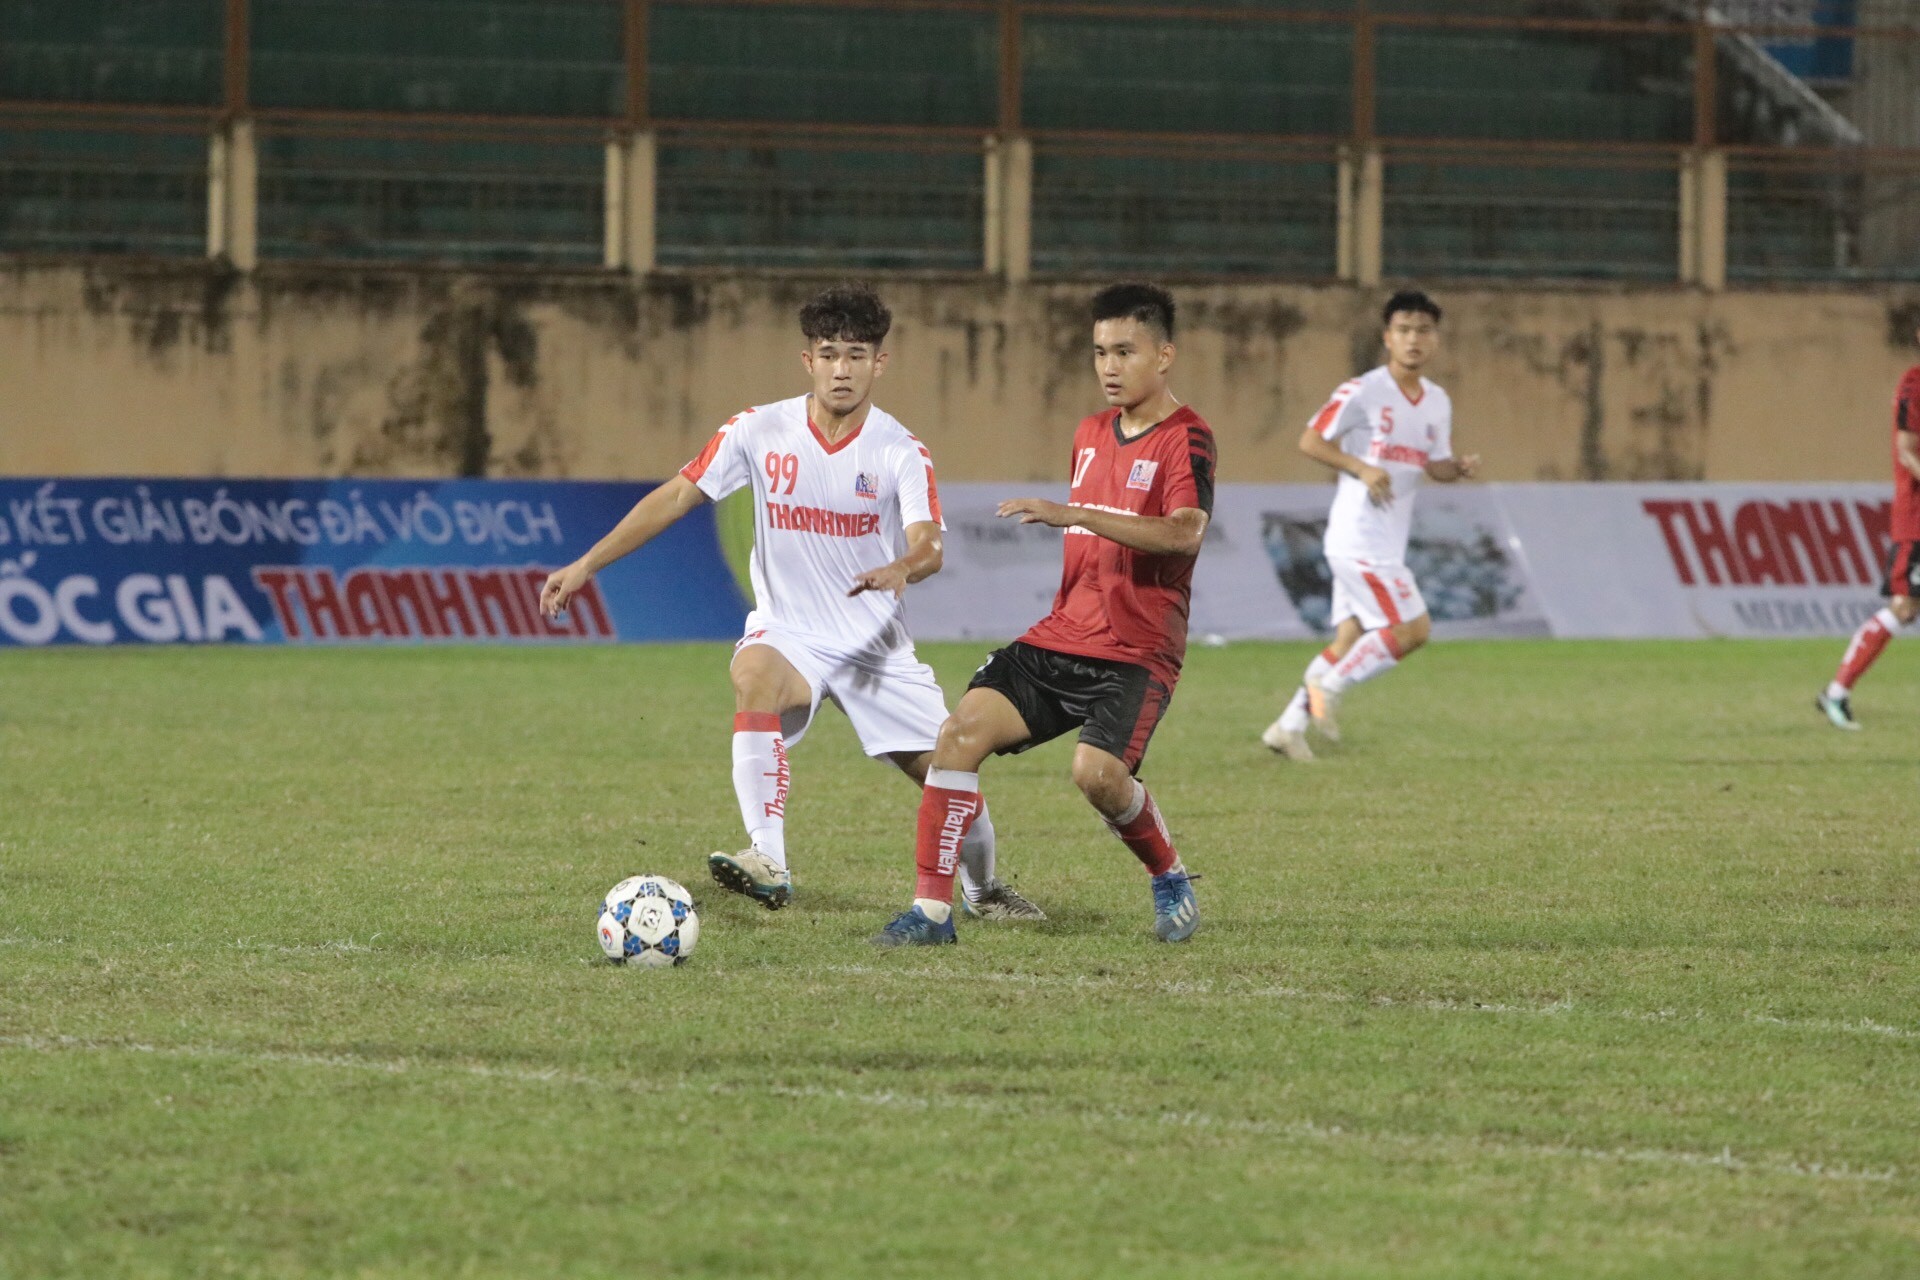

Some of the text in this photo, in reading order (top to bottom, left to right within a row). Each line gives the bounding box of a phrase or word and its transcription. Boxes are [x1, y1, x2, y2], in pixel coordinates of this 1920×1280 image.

[1379, 406, 1394, 434] 5
[765, 451, 799, 495] 99
[9, 482, 86, 545] KẾT
[182, 489, 320, 545] BÓNG
[317, 490, 386, 545] ĐÁ
[378, 491, 453, 545] VÔ
[455, 500, 563, 553] ĐỊCH
[116, 574, 263, 642] GIA
